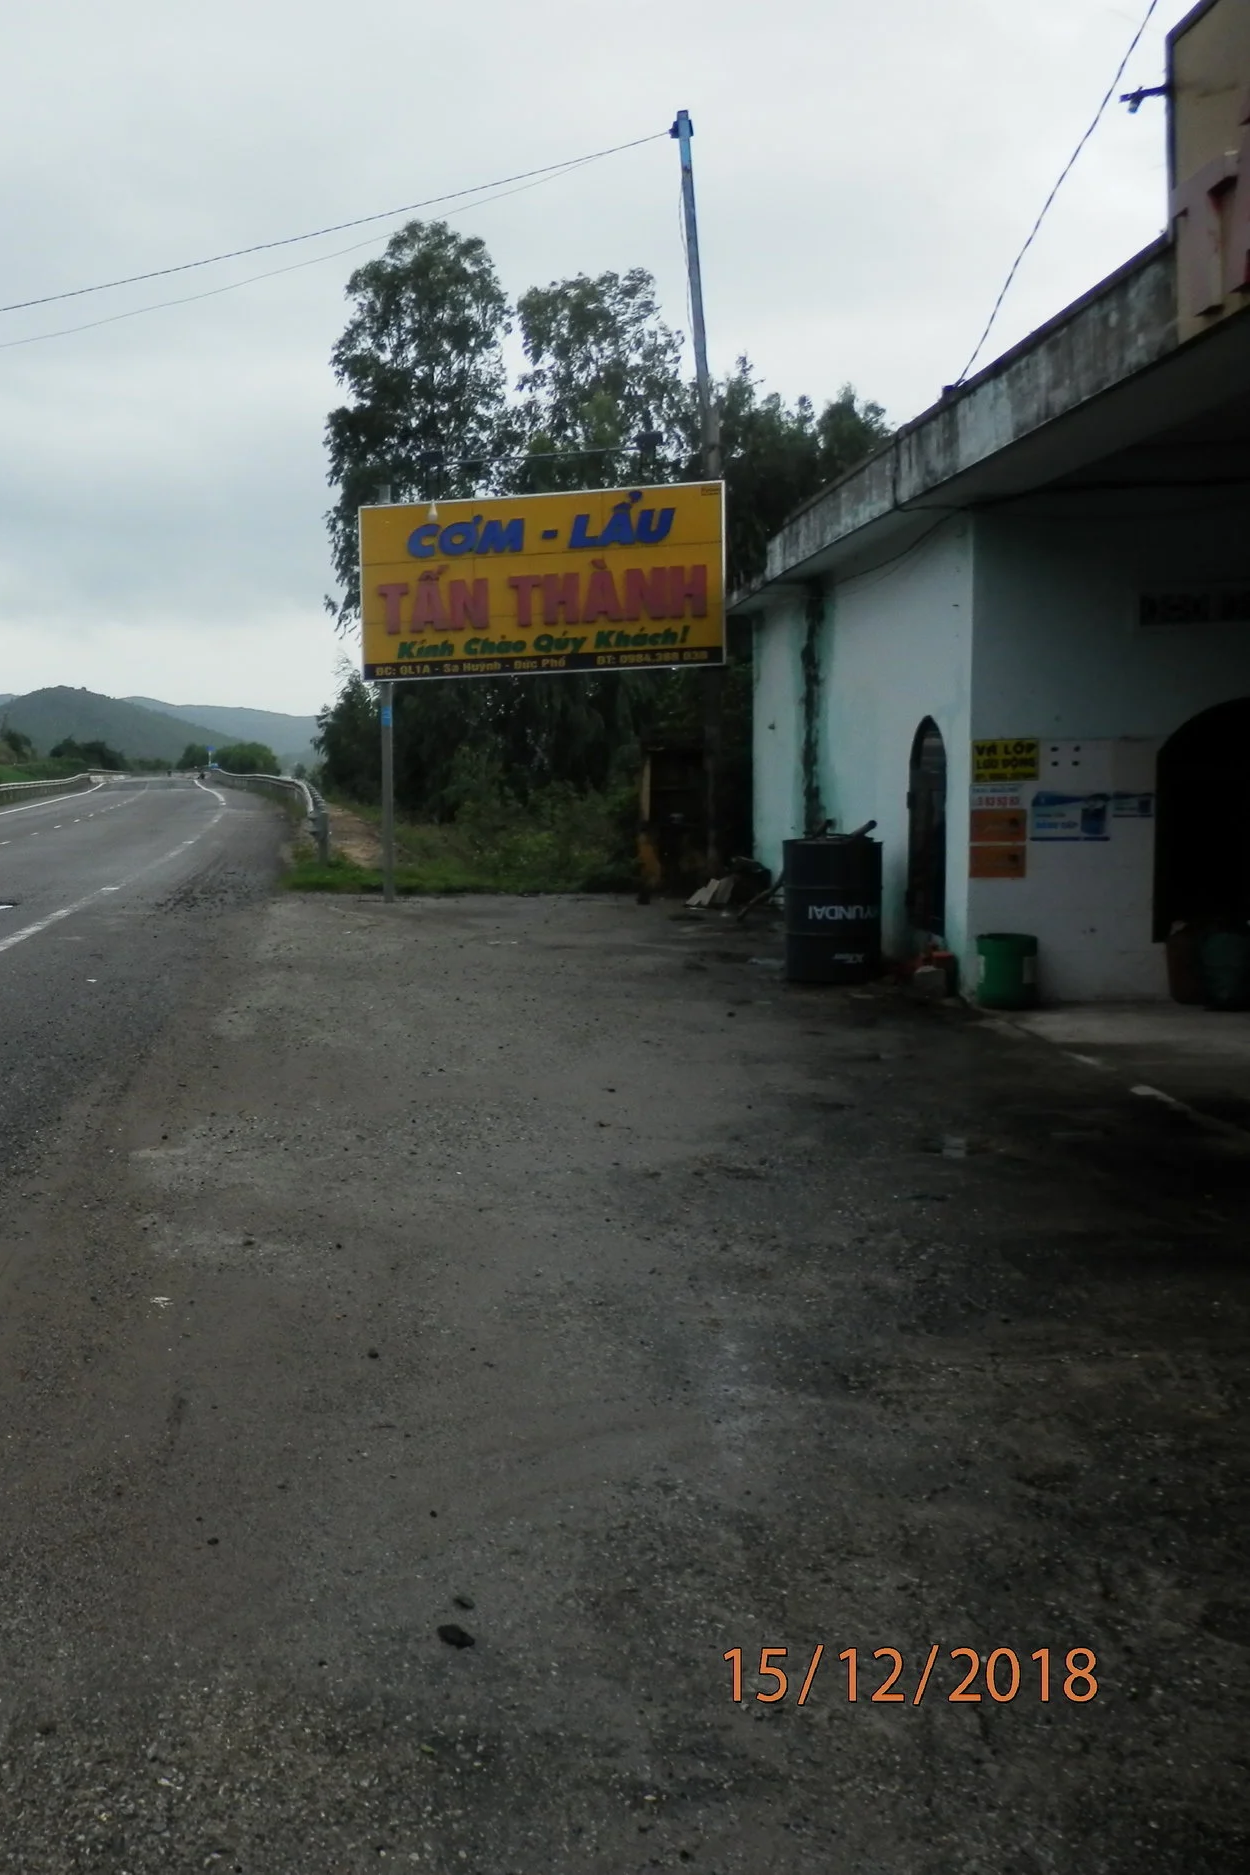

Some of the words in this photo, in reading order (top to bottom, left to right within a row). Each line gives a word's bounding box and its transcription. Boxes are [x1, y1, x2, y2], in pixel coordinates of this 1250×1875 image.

[406, 514, 525, 559] CƠM
[508, 558, 707, 627] THÀNH
[807, 904, 879, 921] YUNDAI
